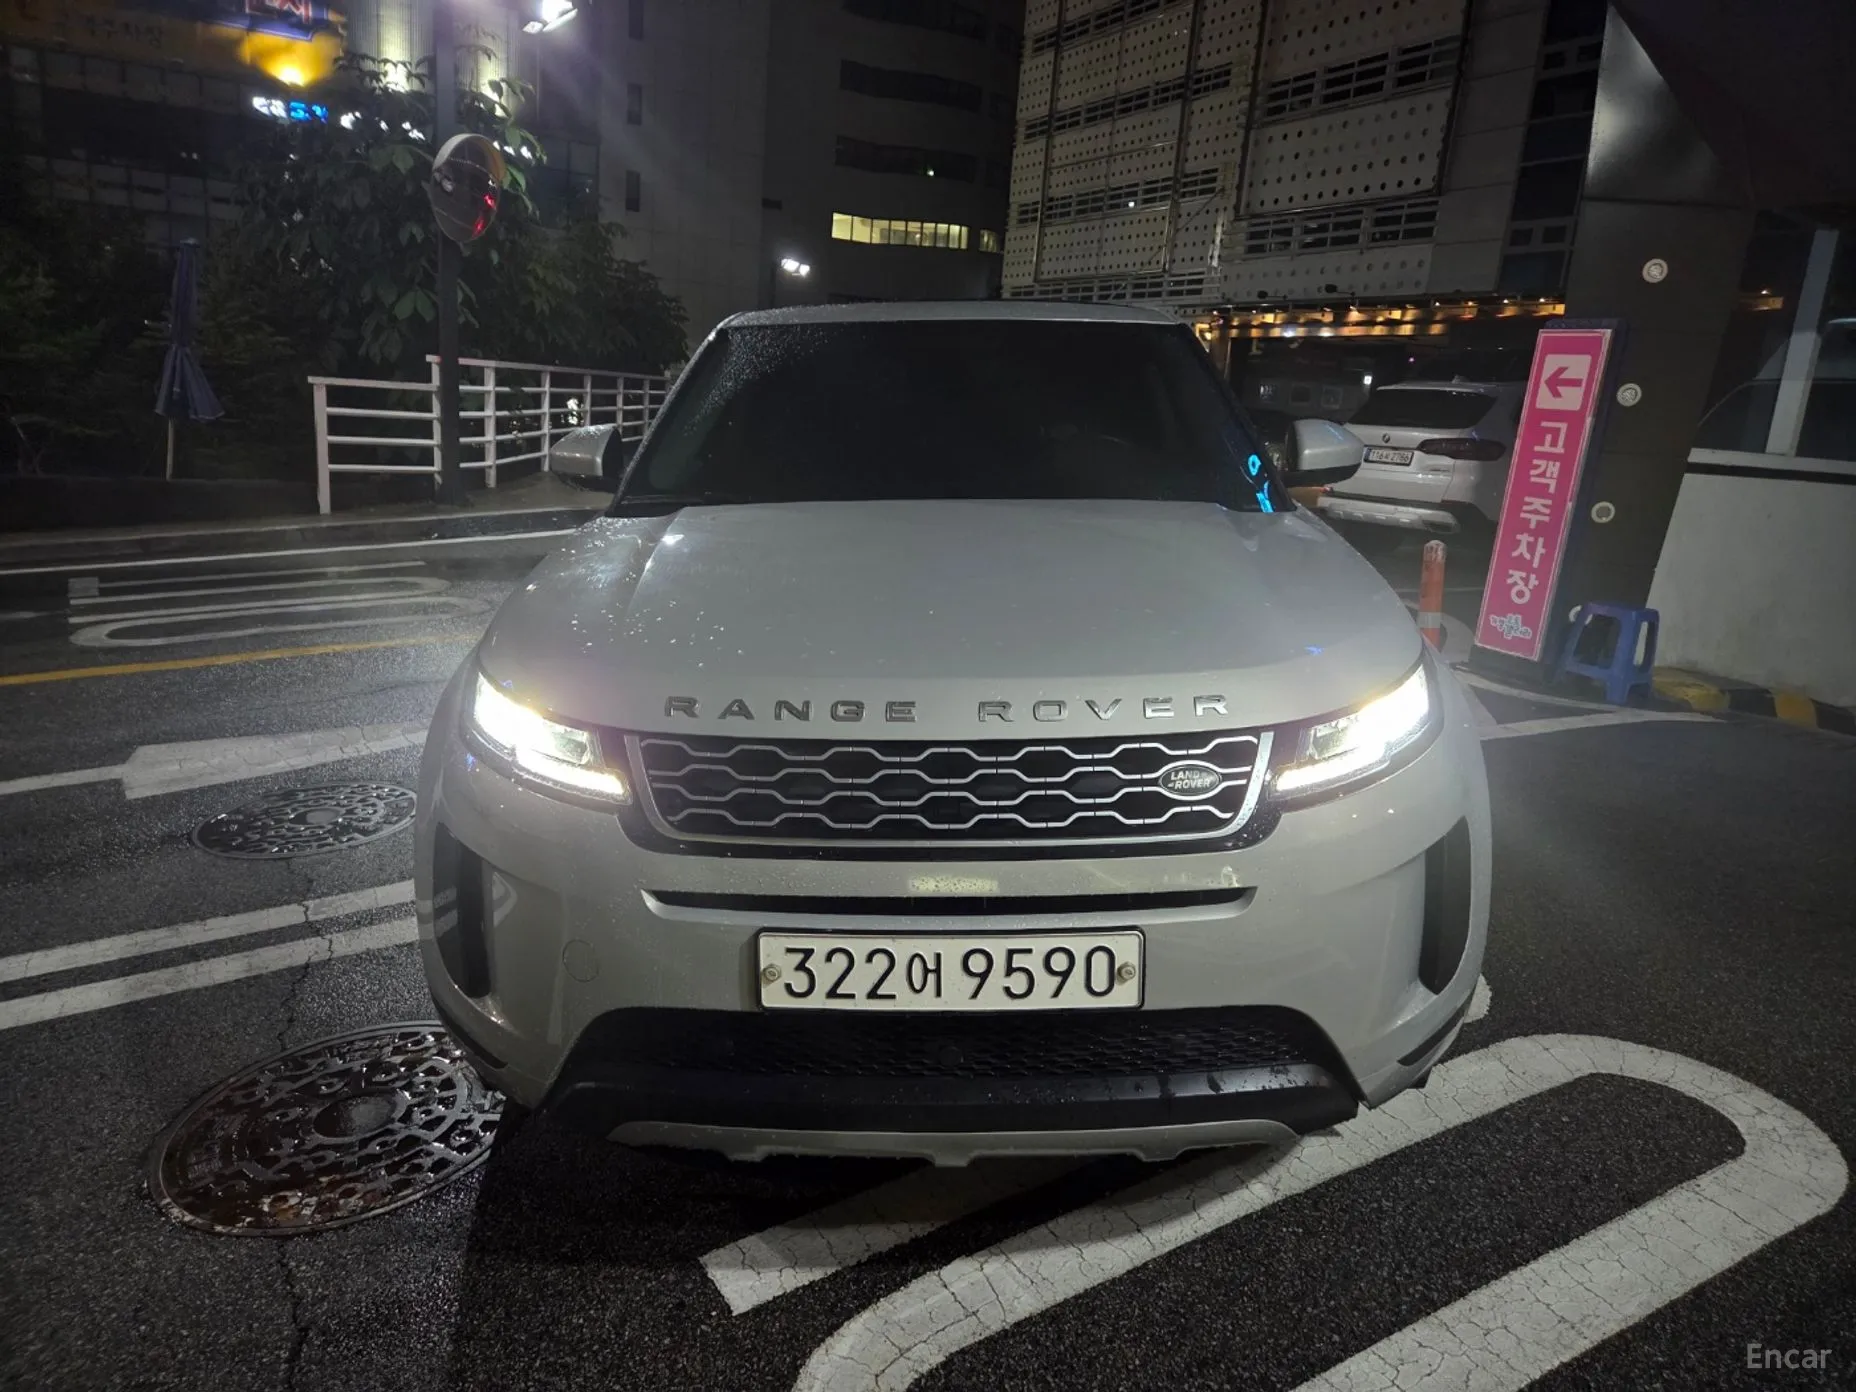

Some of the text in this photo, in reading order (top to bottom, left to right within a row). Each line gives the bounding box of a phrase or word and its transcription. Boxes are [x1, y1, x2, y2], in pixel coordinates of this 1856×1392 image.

[1506, 420, 1568, 605] 고객주차장
[664, 694, 1231, 722] RANGE ROVER
[1170, 770, 1200, 781] LAND
[1174, 778, 1210, 790] ROVER
[783, 944, 1116, 1000] 322어 9590
